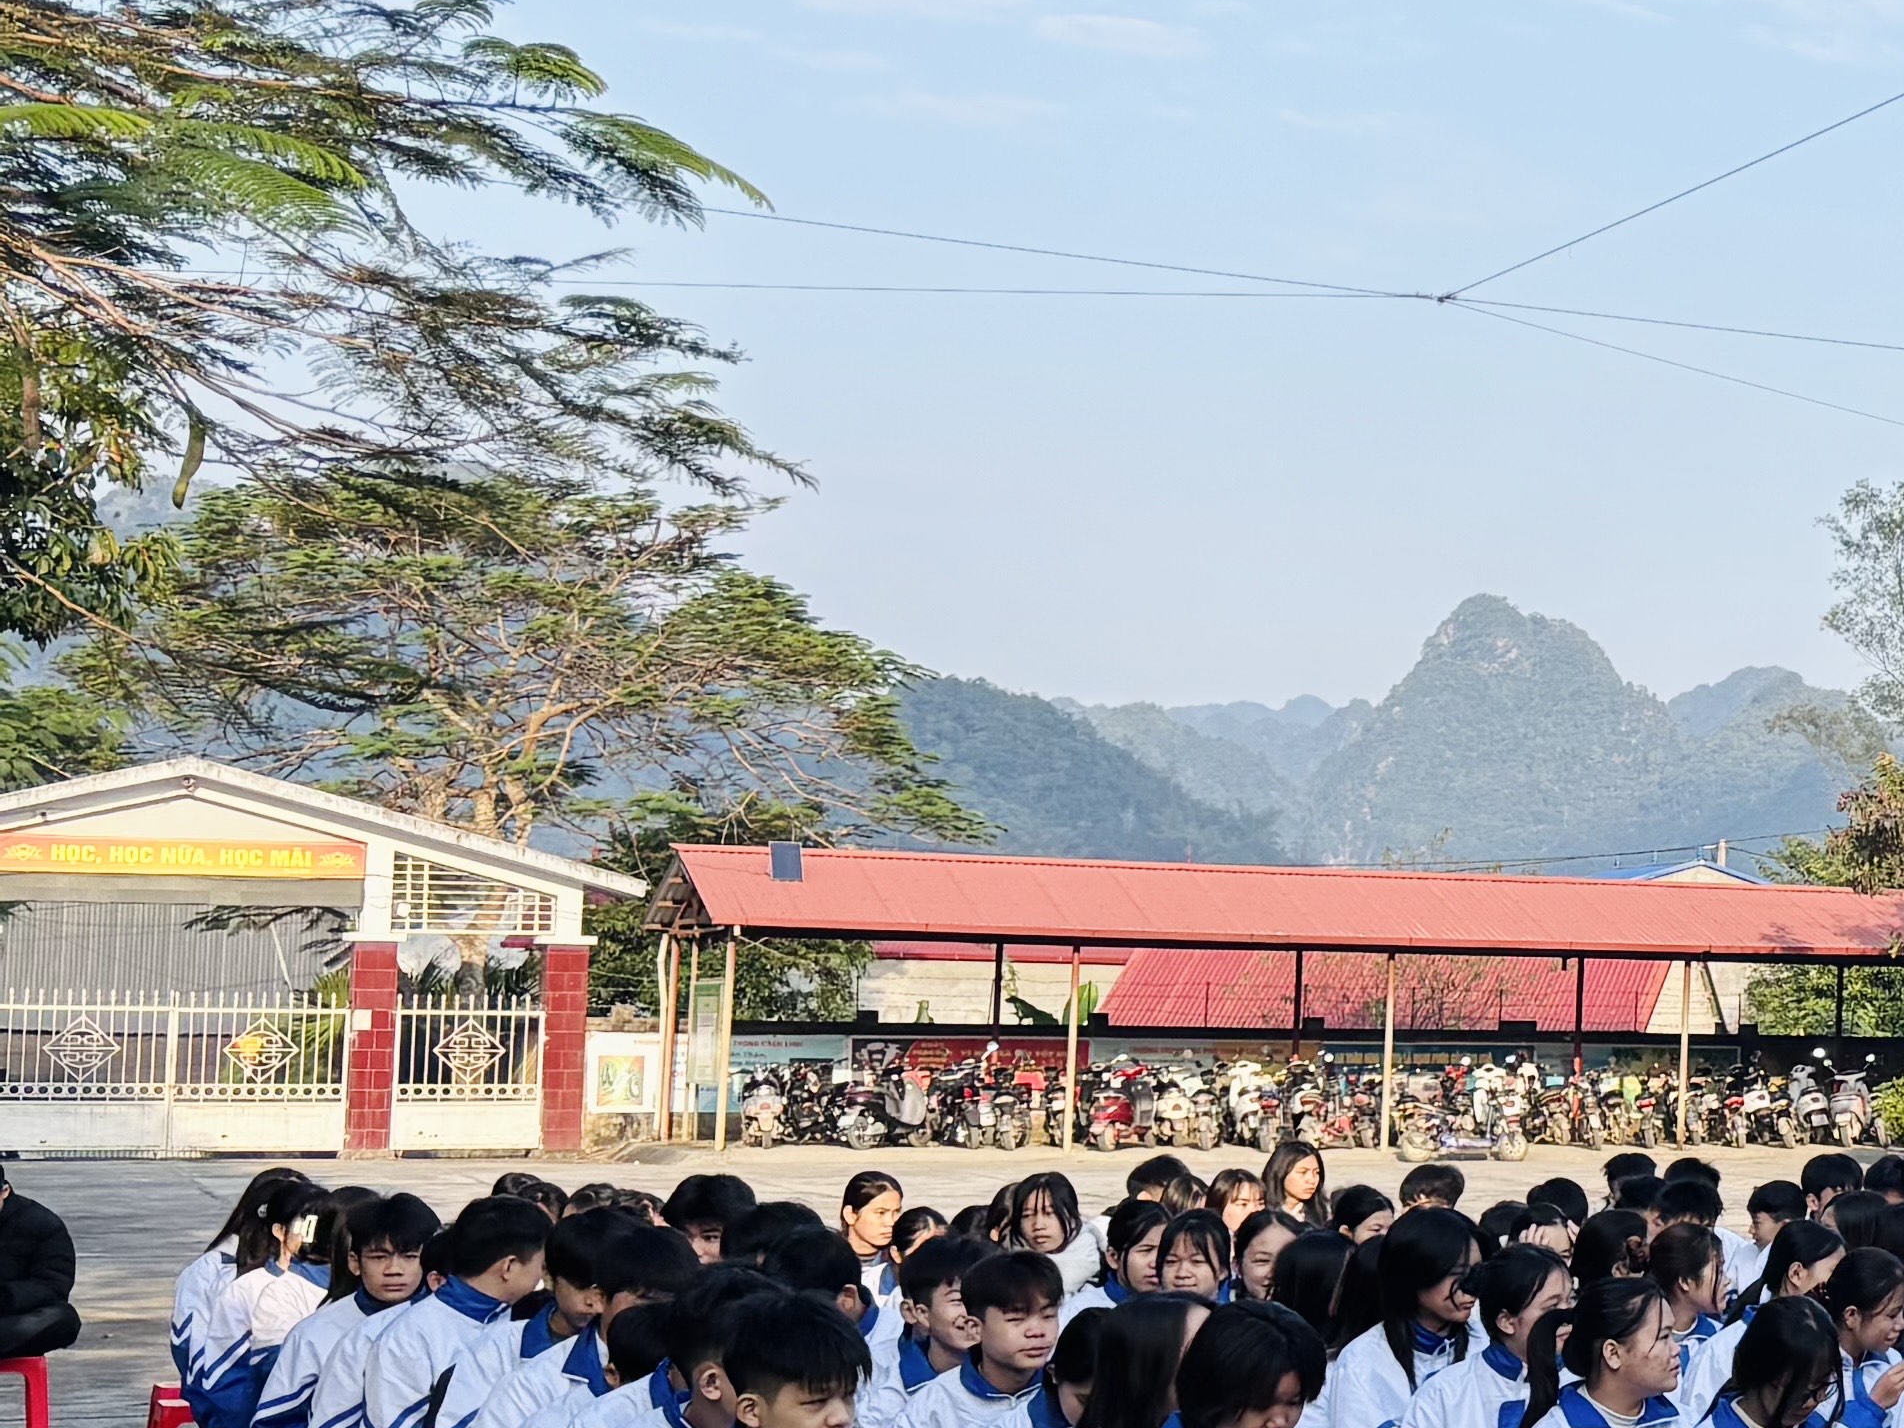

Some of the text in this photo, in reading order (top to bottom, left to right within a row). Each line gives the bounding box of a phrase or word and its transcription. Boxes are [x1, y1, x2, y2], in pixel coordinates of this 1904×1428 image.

[51, 843, 102, 865] HỌC,
[110, 845, 154, 866] HỌC
[220, 847, 263, 869] HỌC
